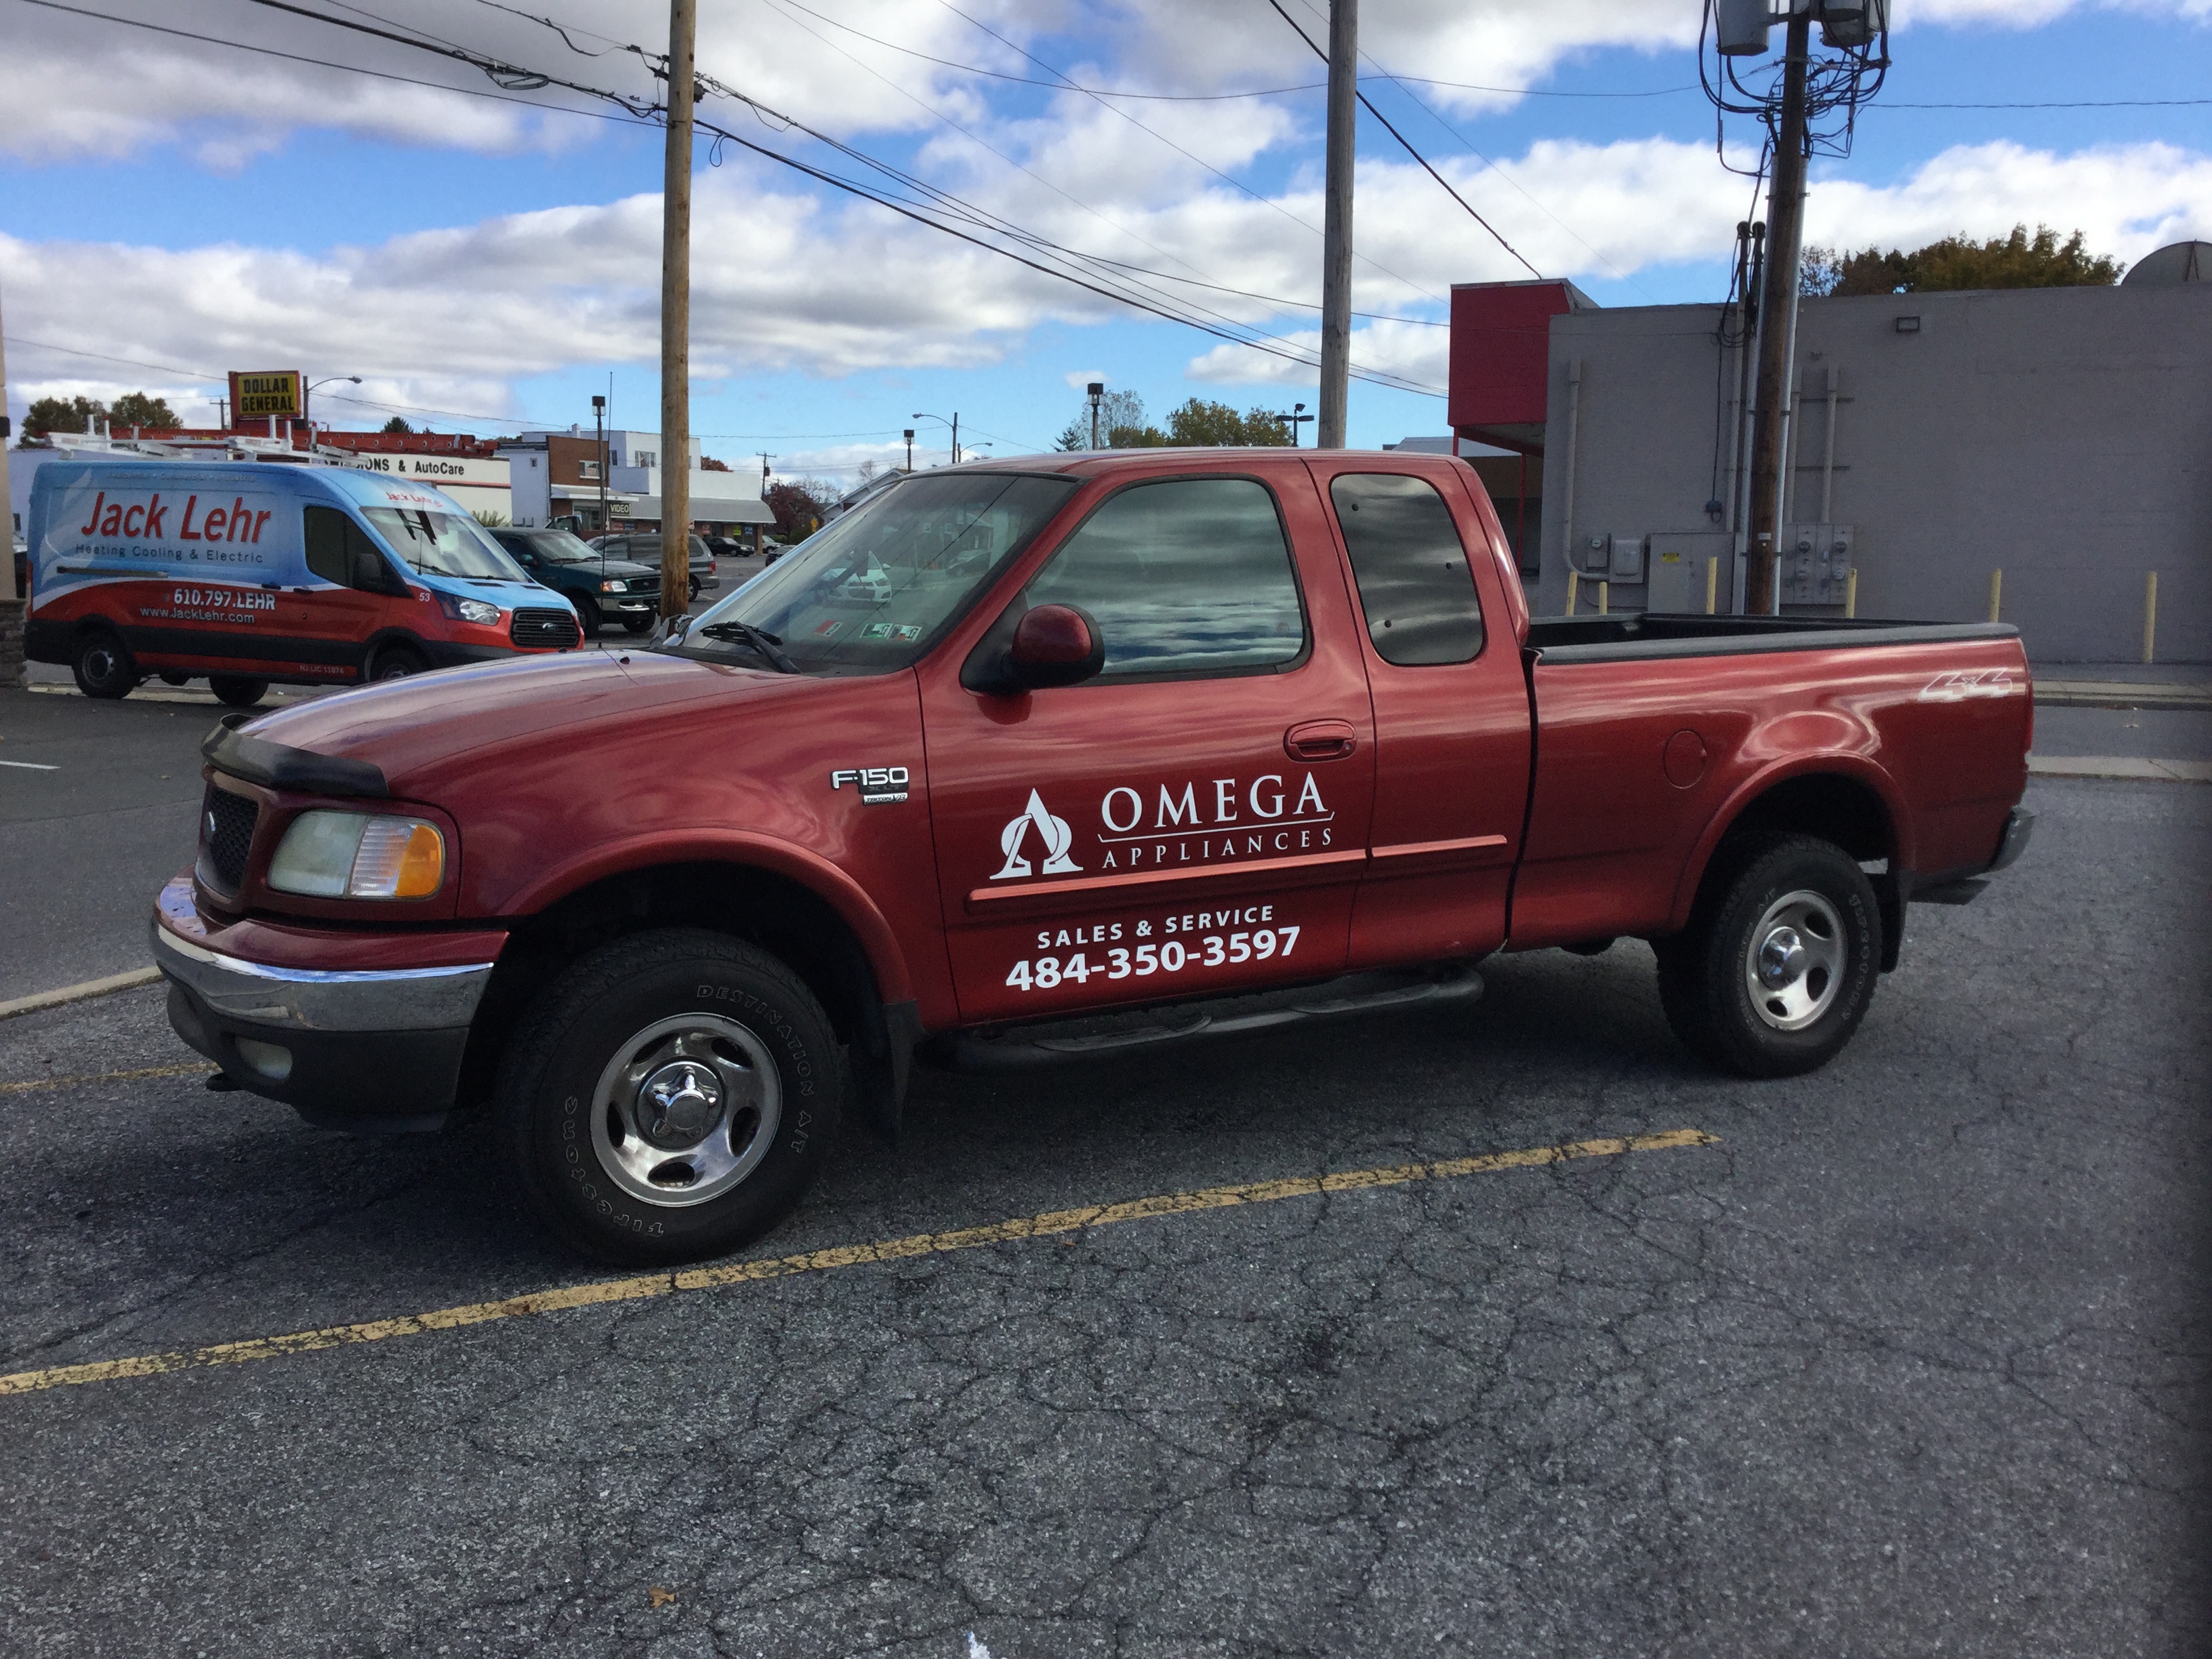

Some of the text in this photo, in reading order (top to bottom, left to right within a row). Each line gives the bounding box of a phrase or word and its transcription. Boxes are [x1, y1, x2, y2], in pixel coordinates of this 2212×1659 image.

[243, 377, 289, 394] DOLLAR
[241, 396, 294, 412] GENERAL
[398, 459, 407, 472] &
[415, 460, 465, 475] AutoCare
[386, 492, 409, 501] Jack
[81, 491, 271, 544] Jack Lehr
[611, 504, 629, 513] VIDEO
[75, 544, 264, 563] Heating Cooling & Electric
[173, 588, 276, 610] 610.797.LEHR
[419, 592, 430, 602] 53
[140, 607, 255, 623] www.JackLehr.com
[832, 766, 909, 789] F-150
[1101, 771, 1329, 833] OMEGA
[1102, 827, 1332, 869] APPLIANCES
[1037, 905, 1273, 949] SALES & SERVICE
[1005, 926, 1301, 992] 484-350-3597
[695, 984, 815, 1154] DESTINATION A/T
[562, 1095, 666, 1237] Firestone
